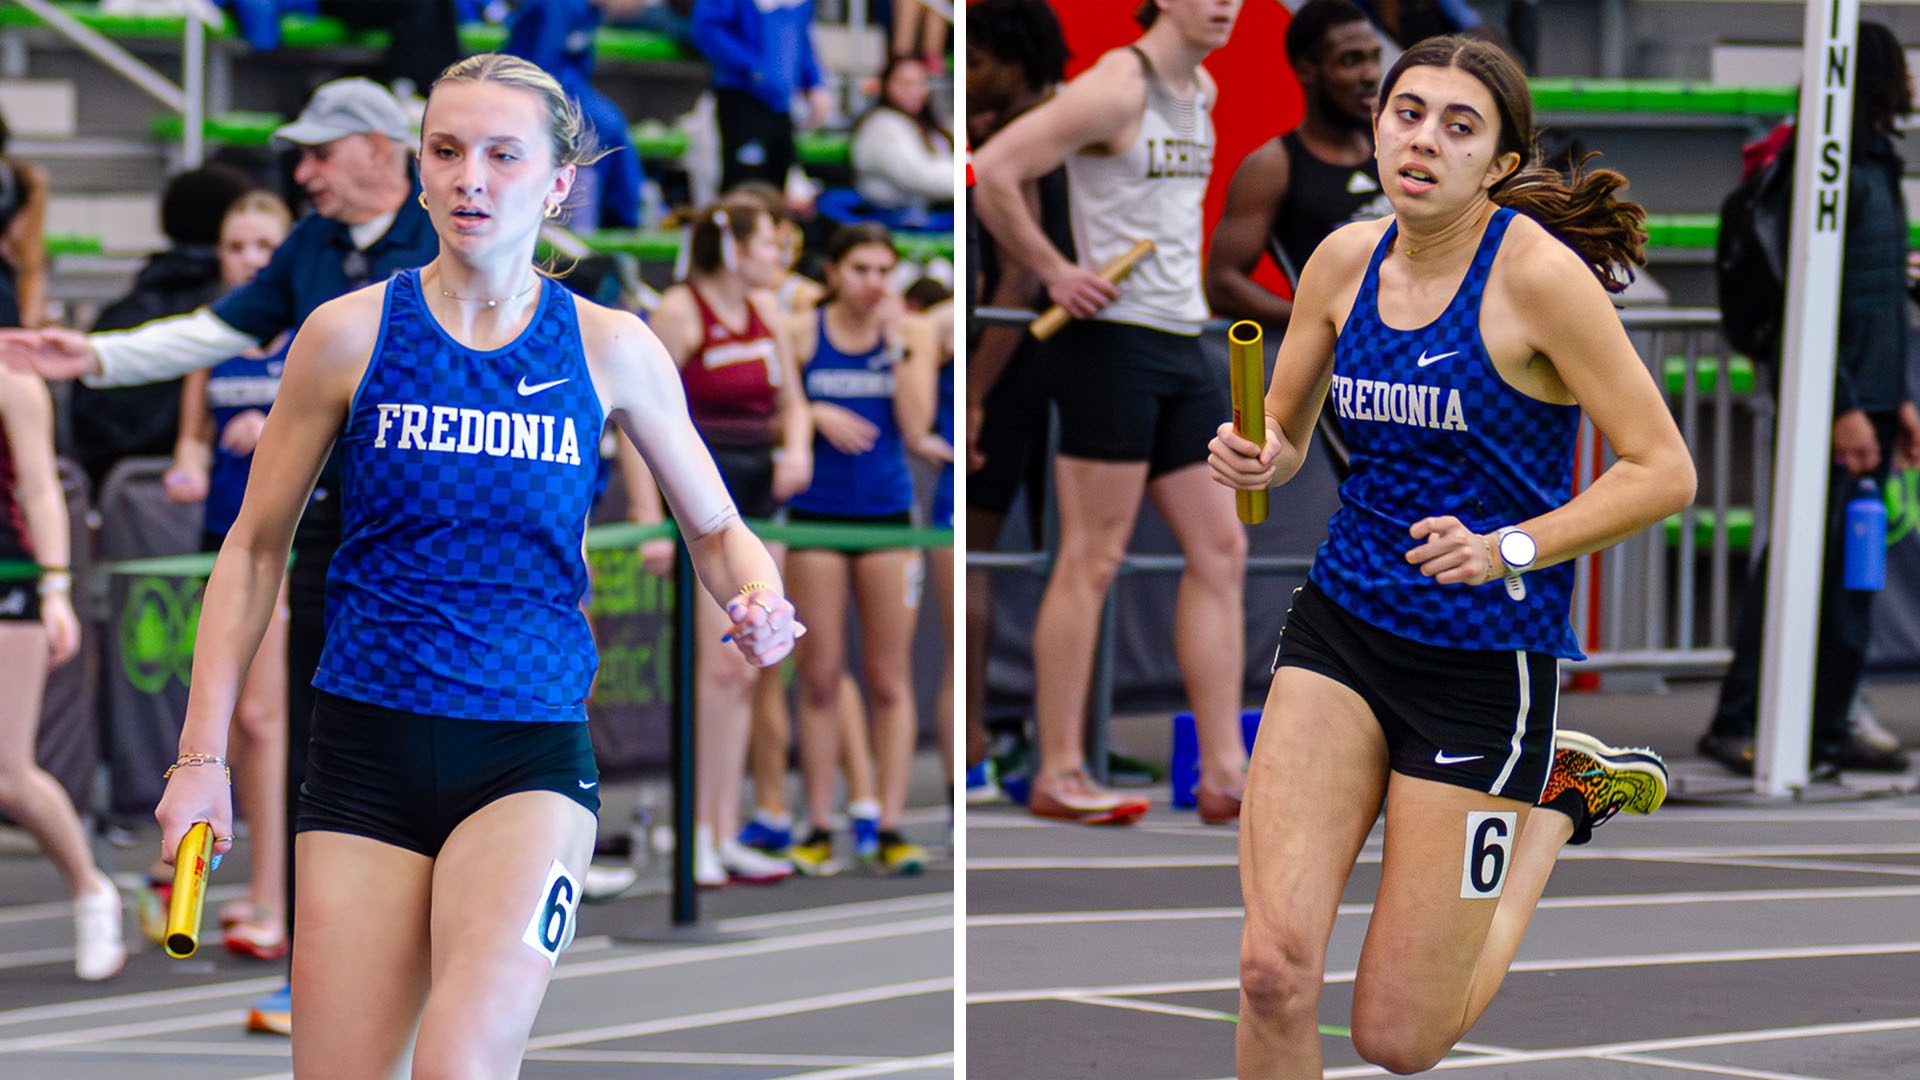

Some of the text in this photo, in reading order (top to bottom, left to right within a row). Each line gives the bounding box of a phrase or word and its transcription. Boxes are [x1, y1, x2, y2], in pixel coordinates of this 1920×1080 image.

[373, 403, 581, 466] FREDONIA
[1470, 817, 1508, 893] 6
[537, 874, 573, 953] 6
